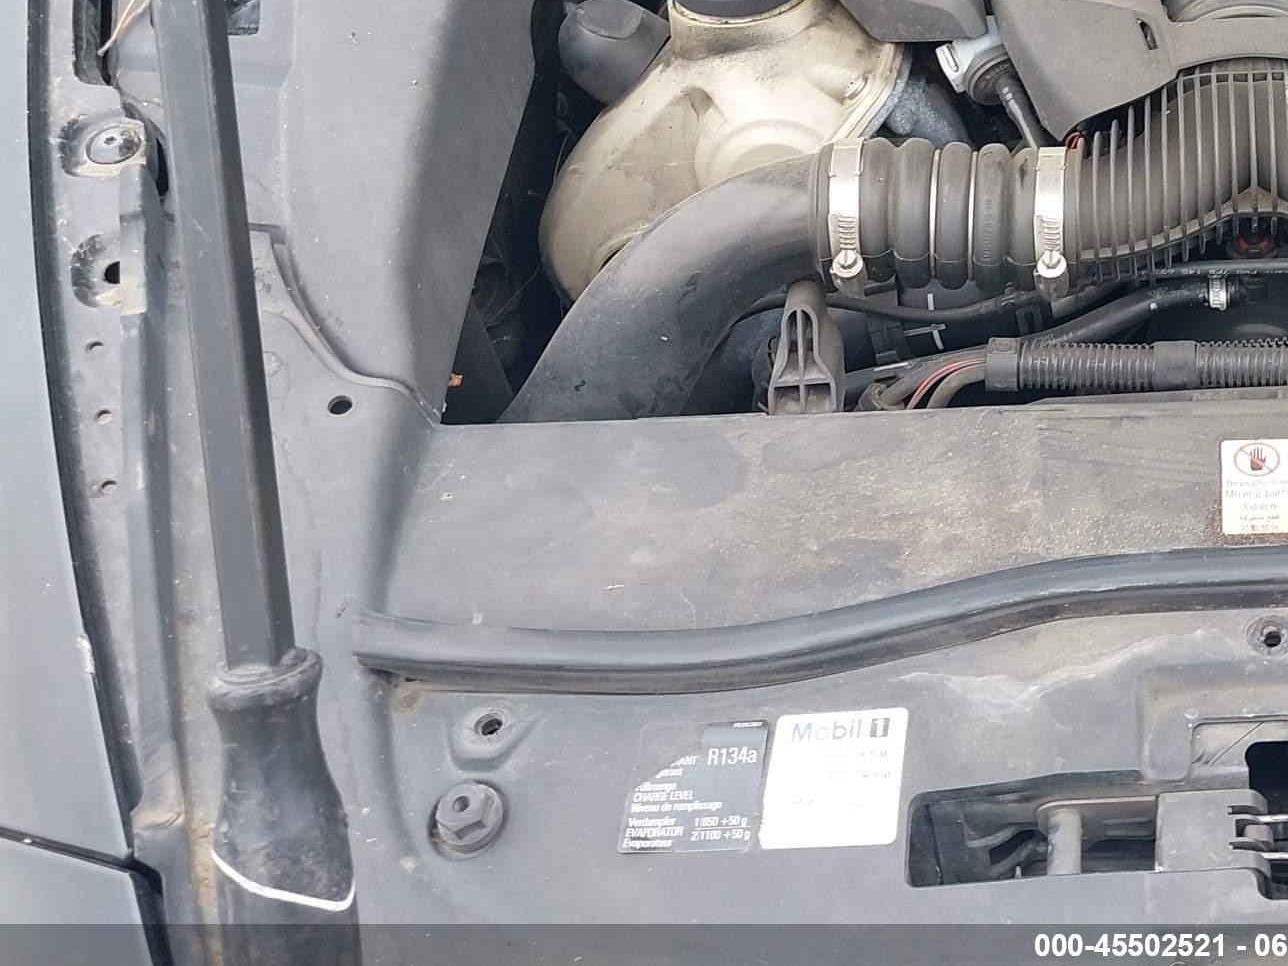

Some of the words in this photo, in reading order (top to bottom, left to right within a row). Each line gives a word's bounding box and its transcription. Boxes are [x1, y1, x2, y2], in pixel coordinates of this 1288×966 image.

[791, 718, 863, 742] Mobil
[871, 718, 889, 738] 1
[706, 746, 757, 766] R134a
[633, 791, 669, 803] CHARGE
[669, 789, 694, 801] LEVEL
[631, 802, 660, 813] Niveau
[661, 802, 673, 812] de
[625, 826, 684, 838] EVAPORATOR
